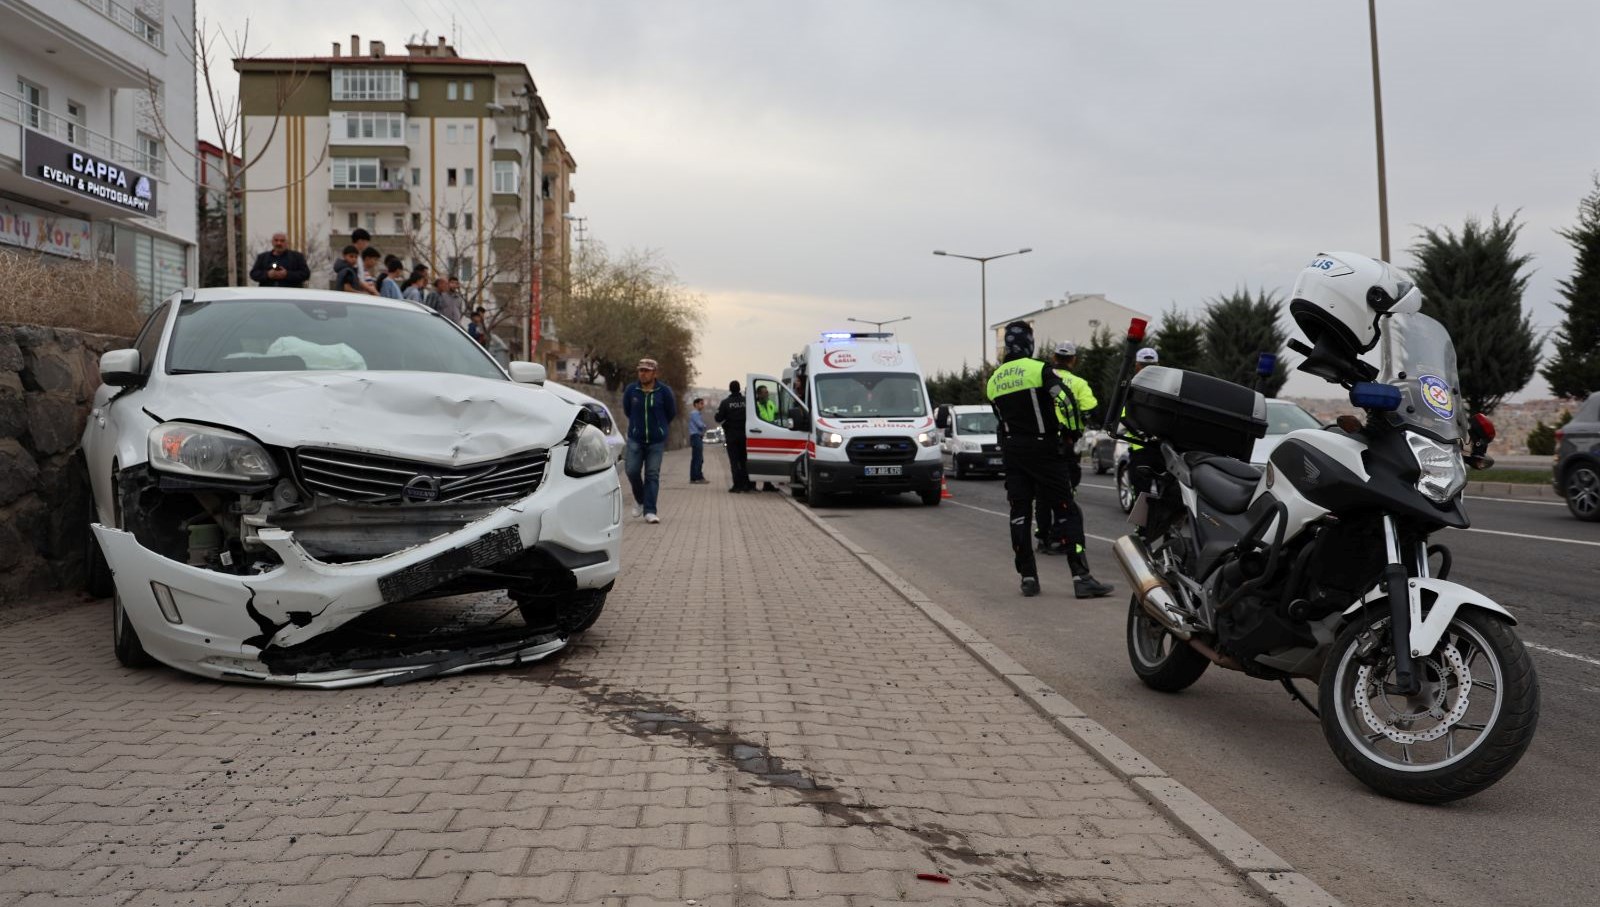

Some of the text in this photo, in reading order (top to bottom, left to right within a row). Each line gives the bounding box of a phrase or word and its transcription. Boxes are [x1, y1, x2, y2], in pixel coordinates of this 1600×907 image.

[43, 165, 150, 211] EVENT & PHOTOGRAPHY
[72, 152, 127, 188] CAPPA
